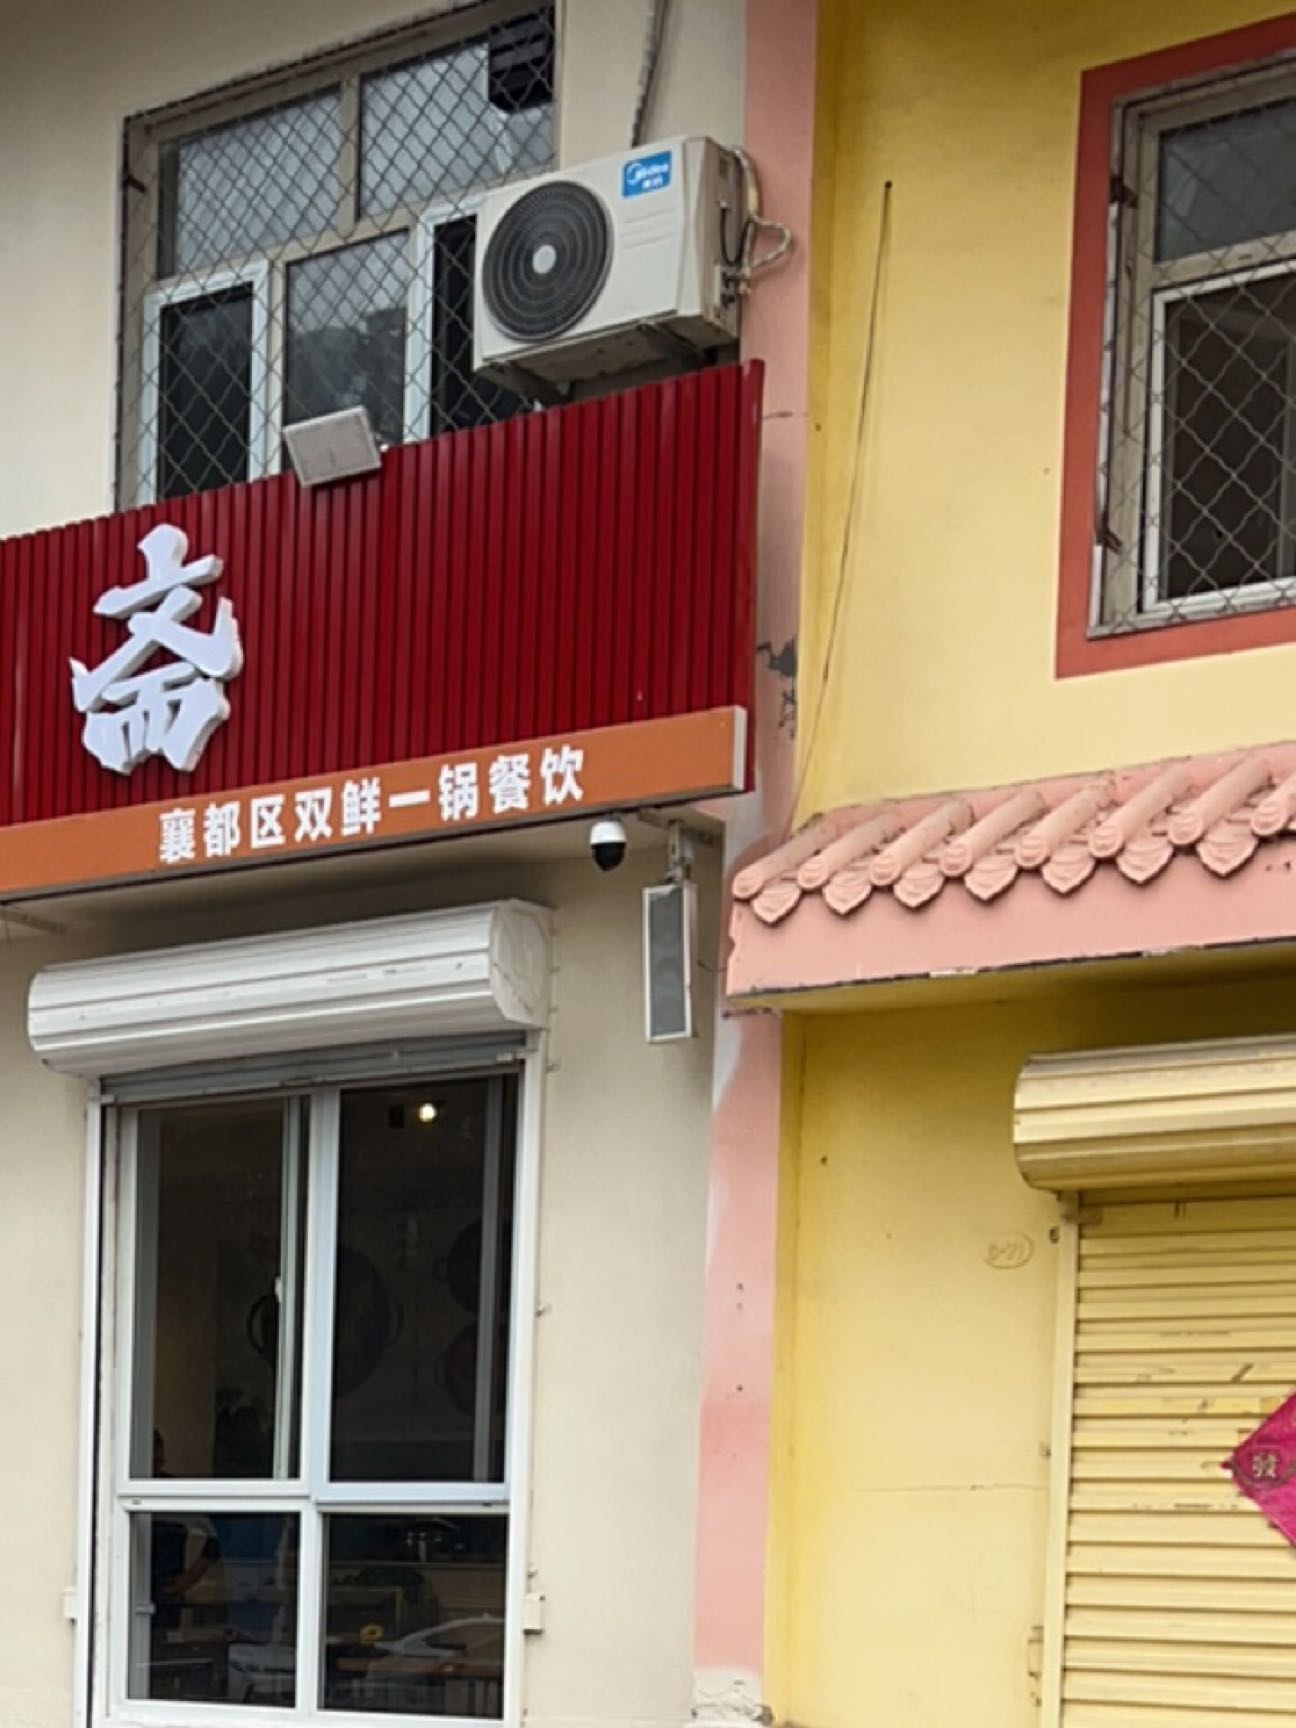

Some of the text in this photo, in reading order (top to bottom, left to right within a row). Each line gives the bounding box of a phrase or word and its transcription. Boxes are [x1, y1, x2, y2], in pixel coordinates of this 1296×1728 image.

[158, 745, 584, 864] 襄都区双鲜一锅餐饮
